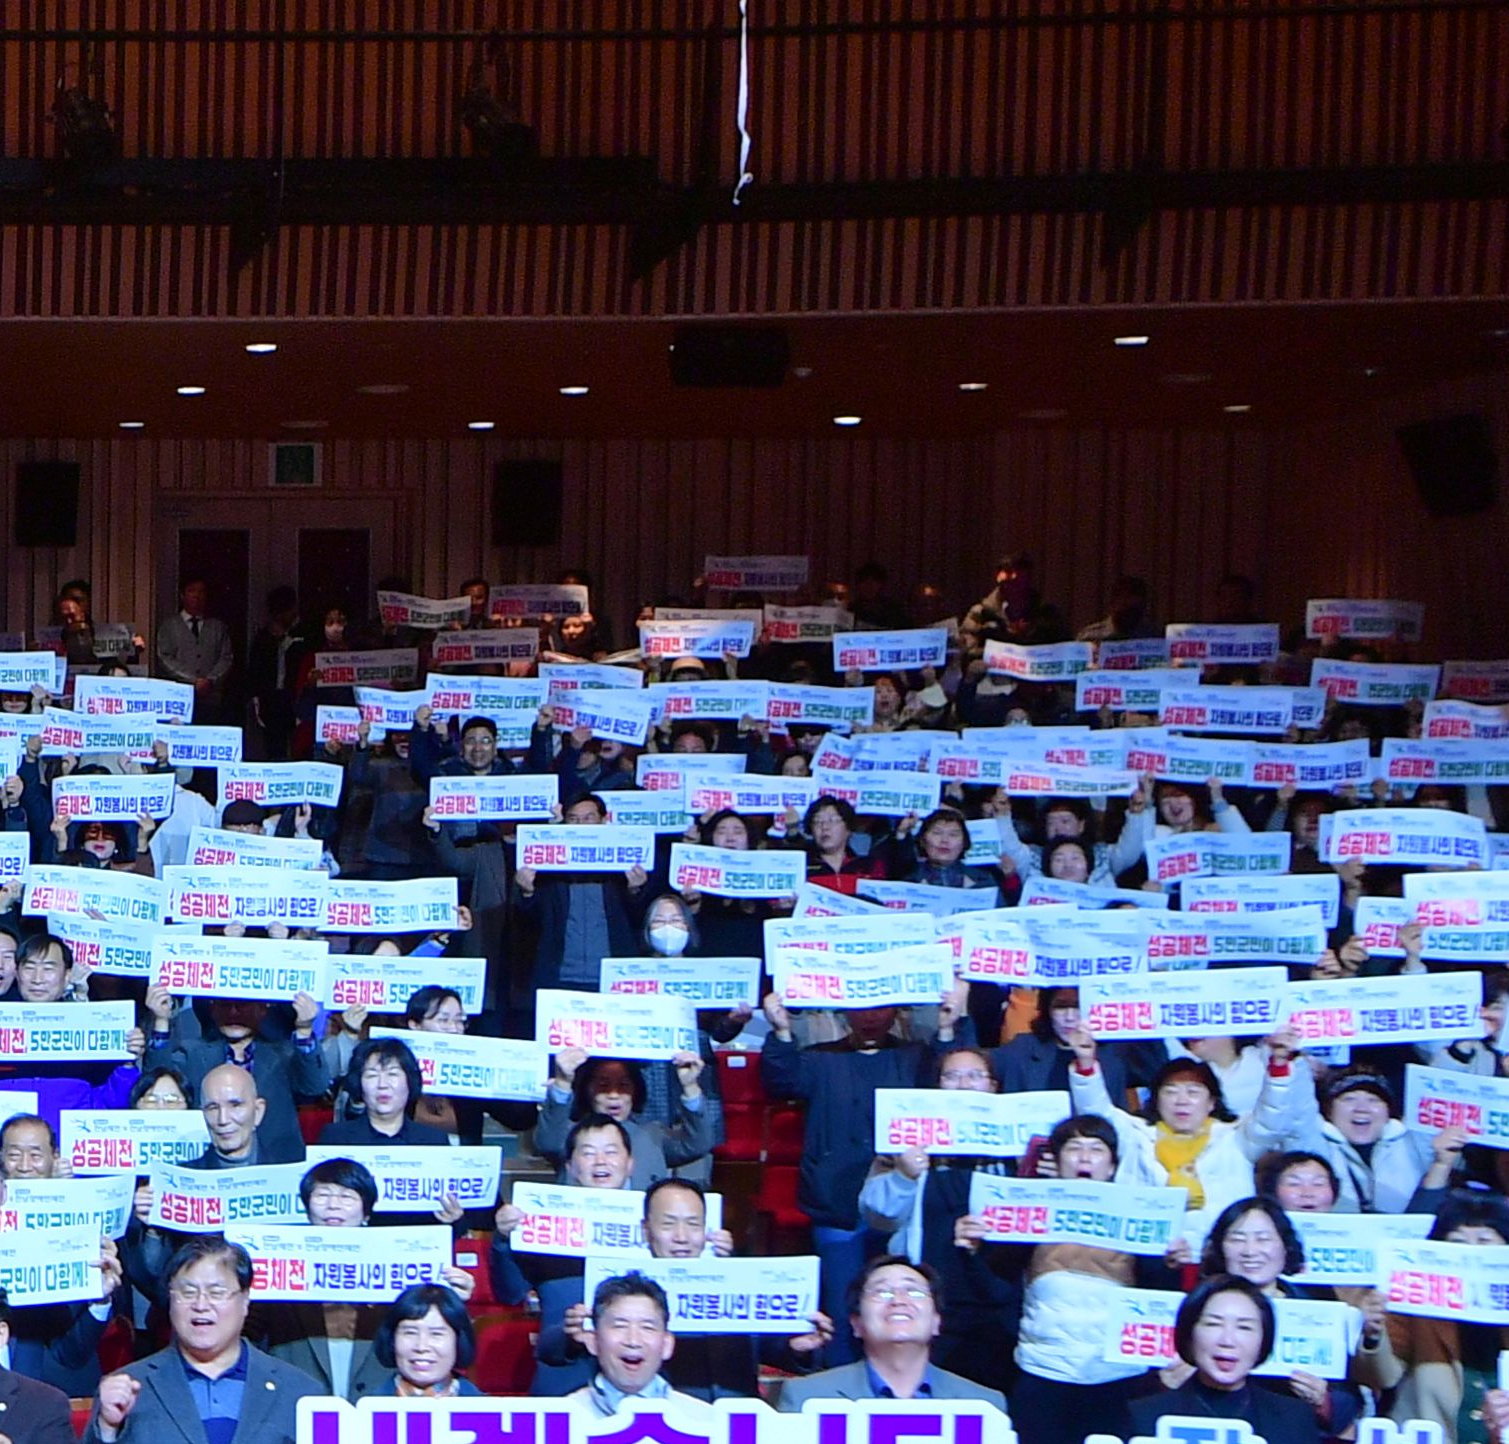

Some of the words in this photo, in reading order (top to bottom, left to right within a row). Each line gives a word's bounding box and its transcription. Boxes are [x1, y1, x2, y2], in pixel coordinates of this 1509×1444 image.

[219, 966, 280, 989] 5만군민이
[277, 969, 315, 991] 다함께!
[1160, 1003, 1226, 1026] 자원봉사의
[1230, 1000, 1281, 1024] 힘으로!
[1359, 1008, 1425, 1032] 자원봉사의
[31, 1030, 85, 1051] 5만군민이
[84, 1030, 126, 1050] 다함께!
[73, 1140, 136, 1167] 성공체전,
[383, 1178, 448, 1203] 자원봉사의
[446, 1178, 496, 1200] 힘으로!
[162, 1195, 225, 1224] 성공체전,
[228, 1193, 291, 1224] 5만군민이
[45, 1261, 89, 1291] 다함께!
[313, 1263, 385, 1289] 자원봉사의
[391, 1263, 448, 1292] 힘으로!
[677, 1294, 750, 1320] 자원봉사의
[755, 1294, 813, 1322] 힘으로!
